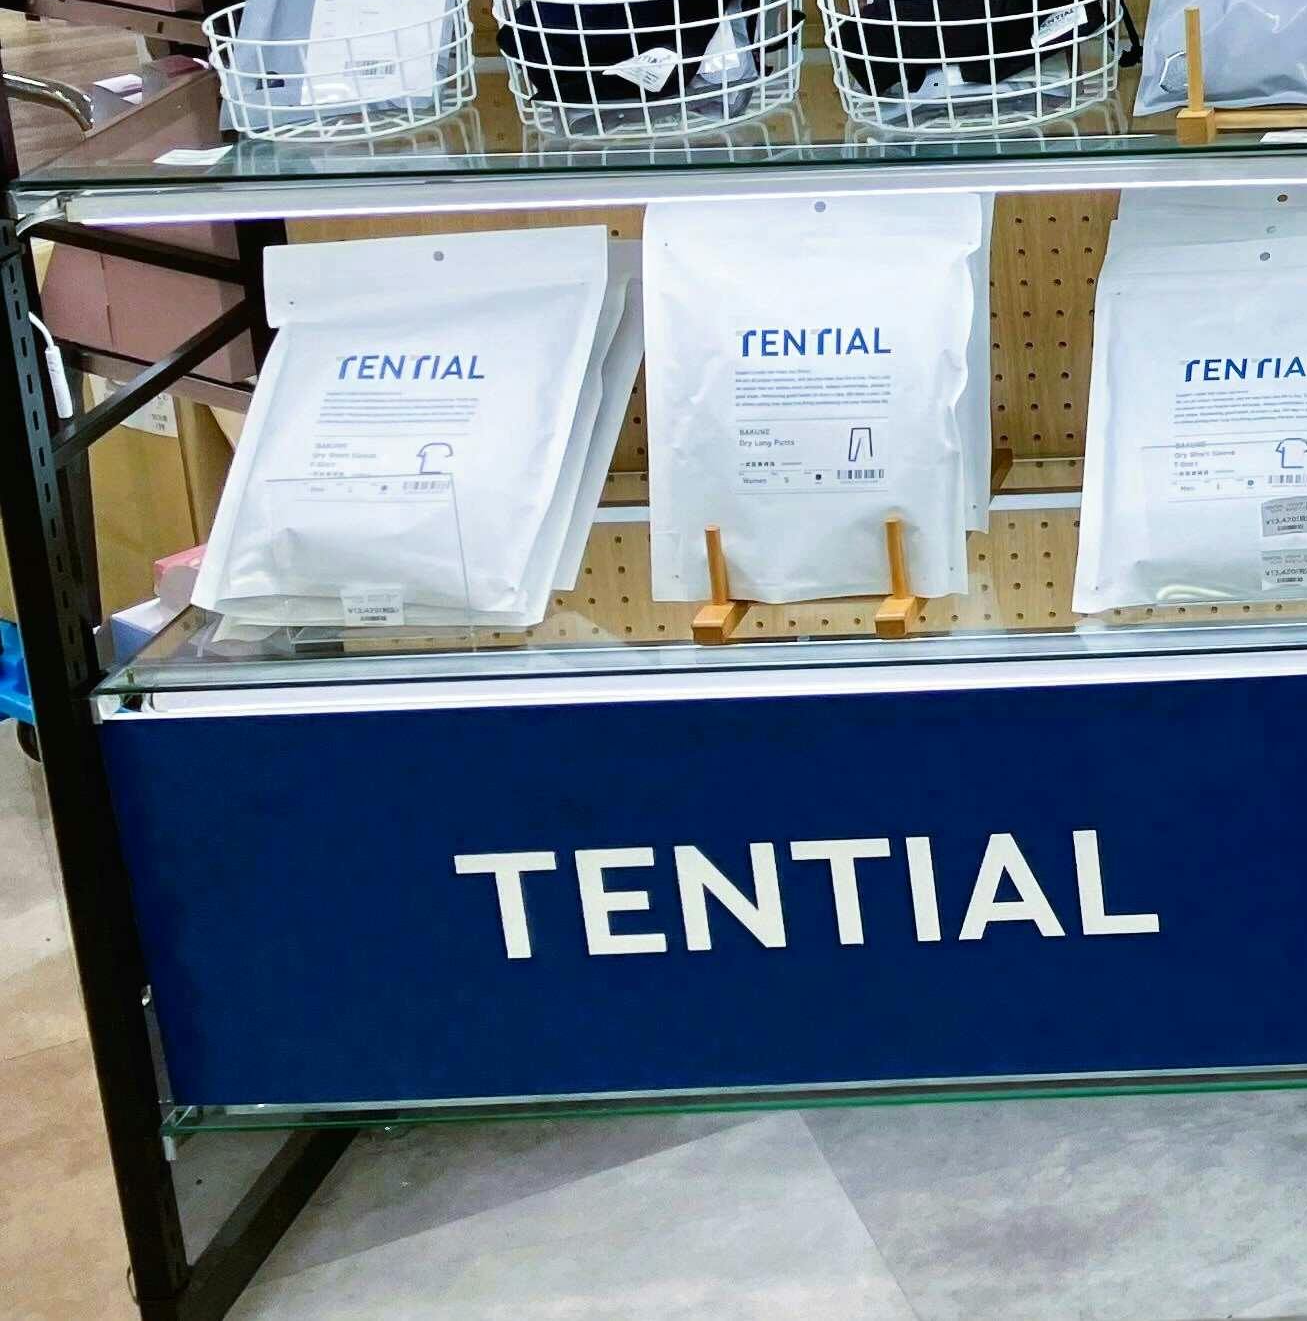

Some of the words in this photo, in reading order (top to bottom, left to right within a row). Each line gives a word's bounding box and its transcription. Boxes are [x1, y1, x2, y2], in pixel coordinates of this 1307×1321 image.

[737, 327, 891, 357] TENTIAL
[337, 354, 486, 380] TENTIAL
[455, 829, 1160, 960] TENTIAL
